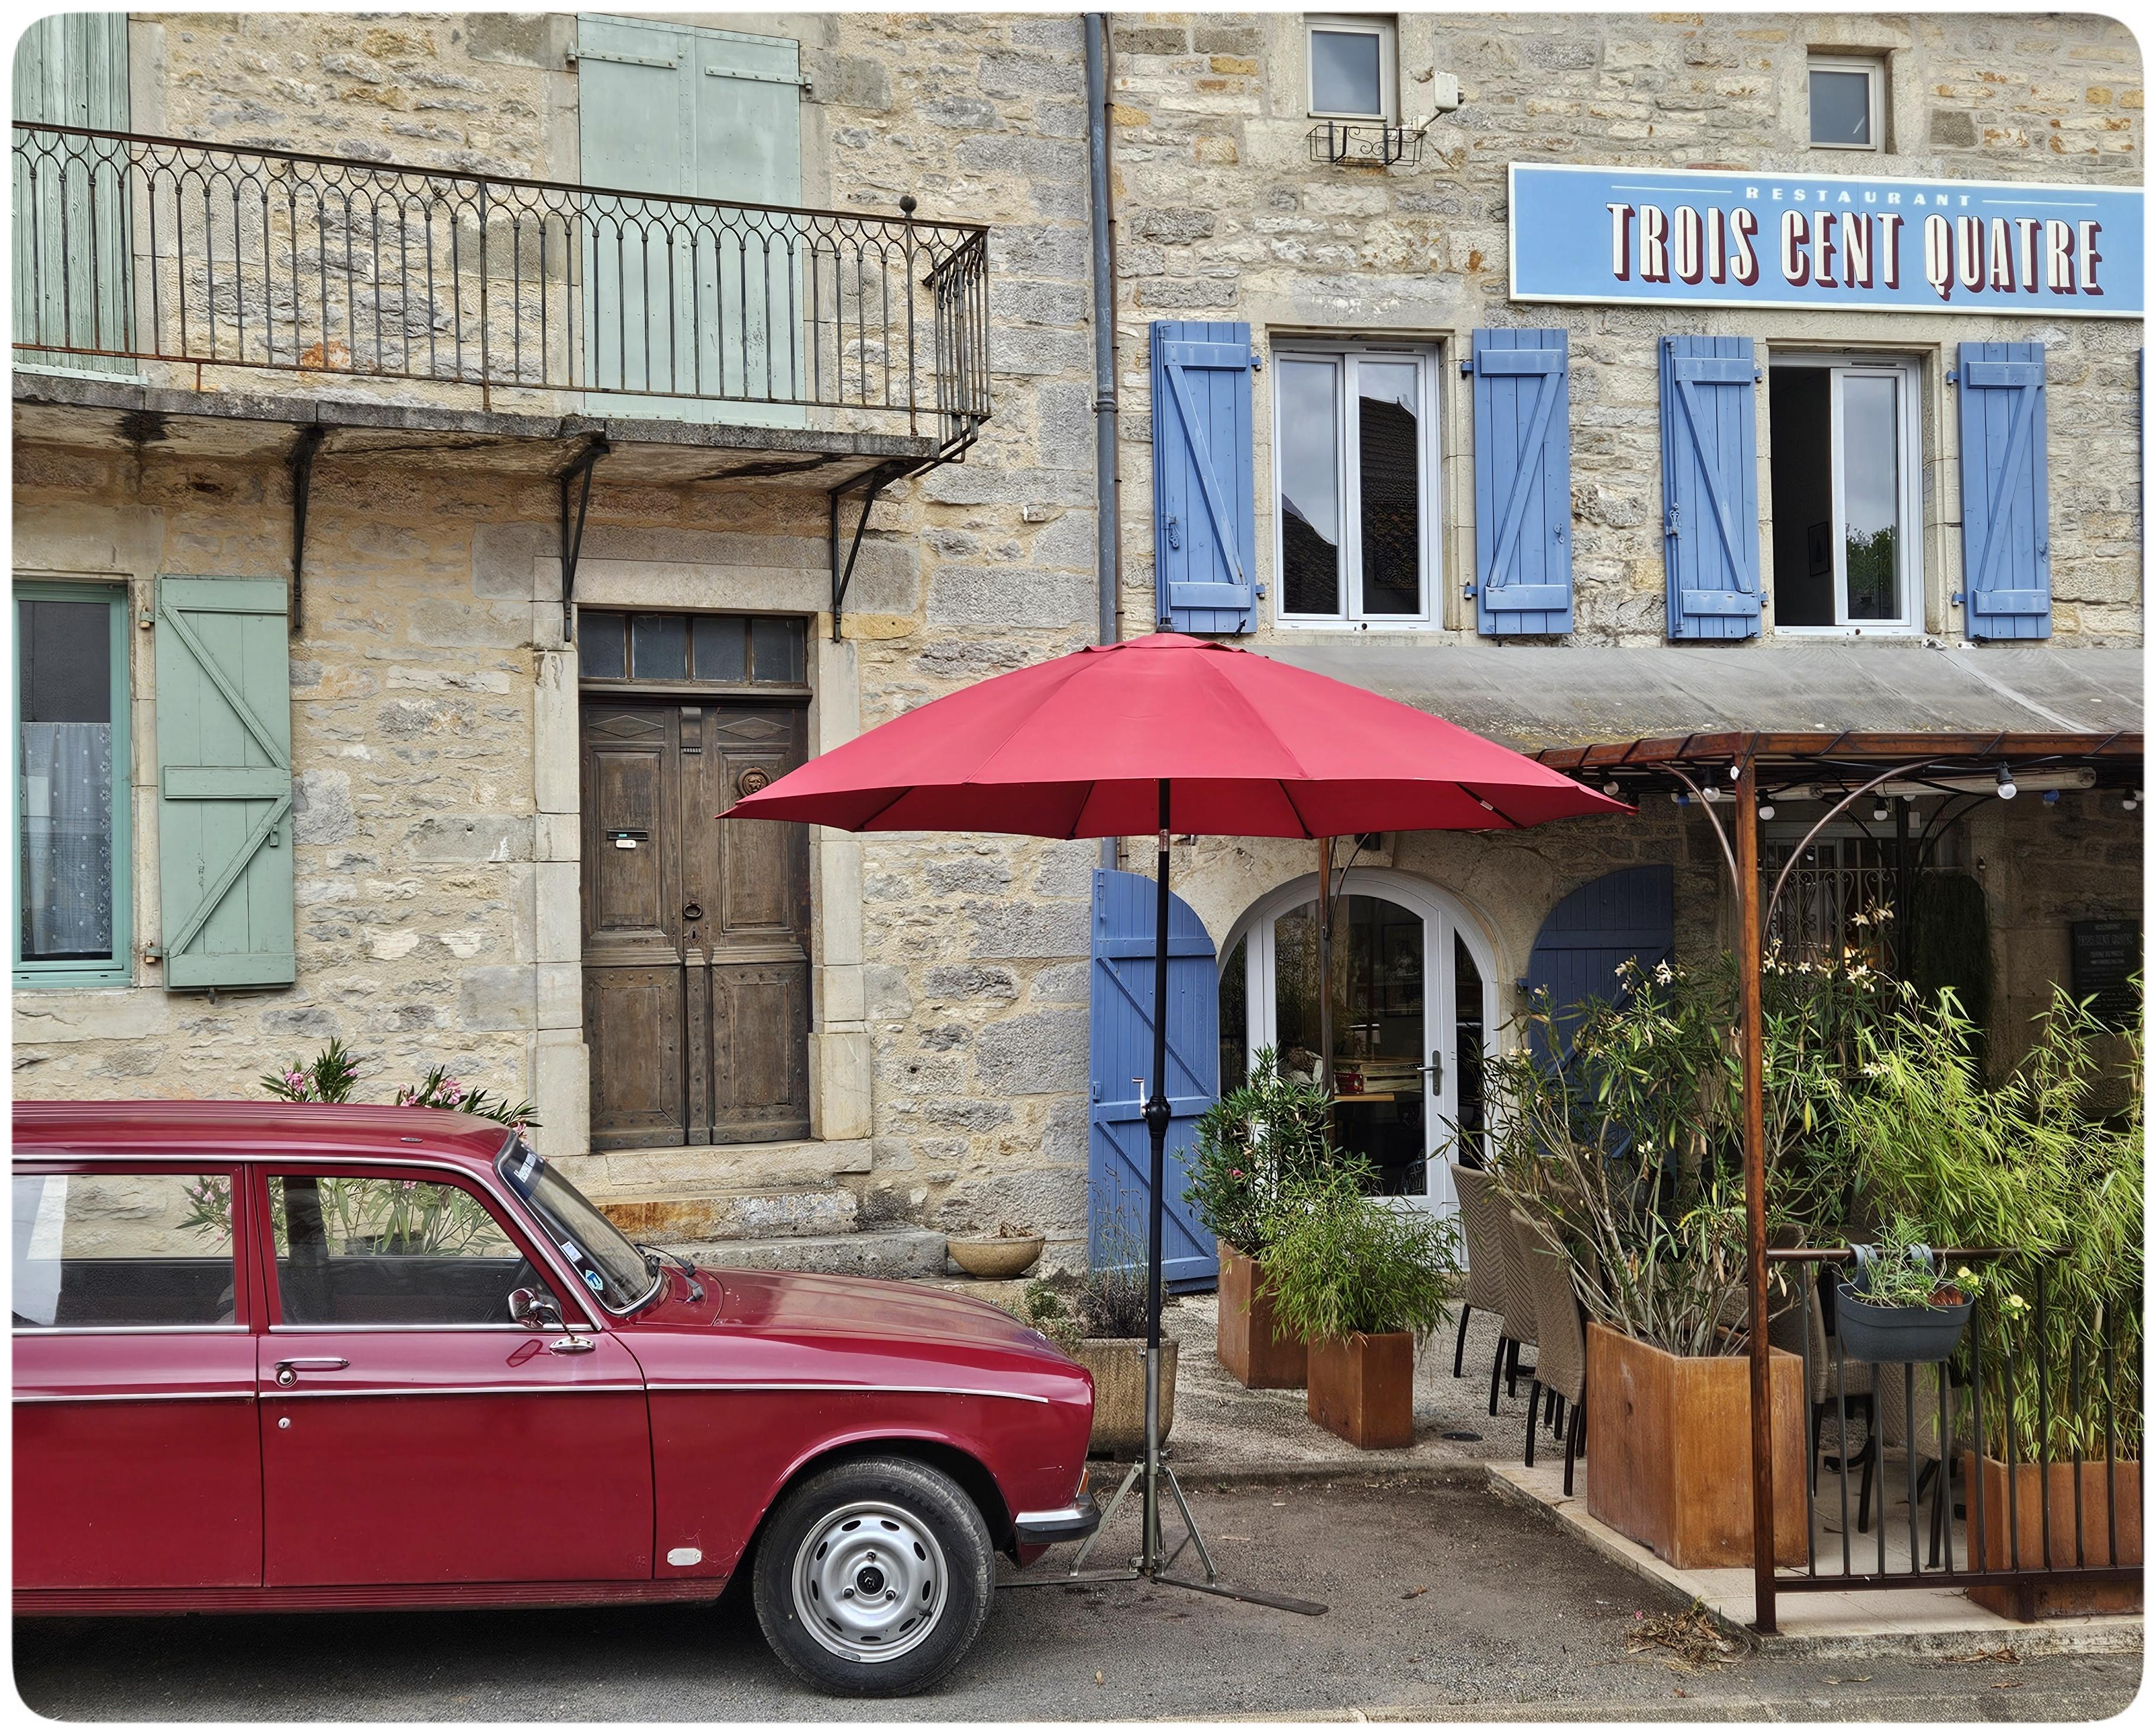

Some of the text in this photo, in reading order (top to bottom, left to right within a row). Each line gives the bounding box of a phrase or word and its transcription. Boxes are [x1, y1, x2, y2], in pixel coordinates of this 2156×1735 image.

[1746, 187, 1971, 206] RESTAURANT
[1606, 202, 2105, 302] TROIS CENT QUATRE
